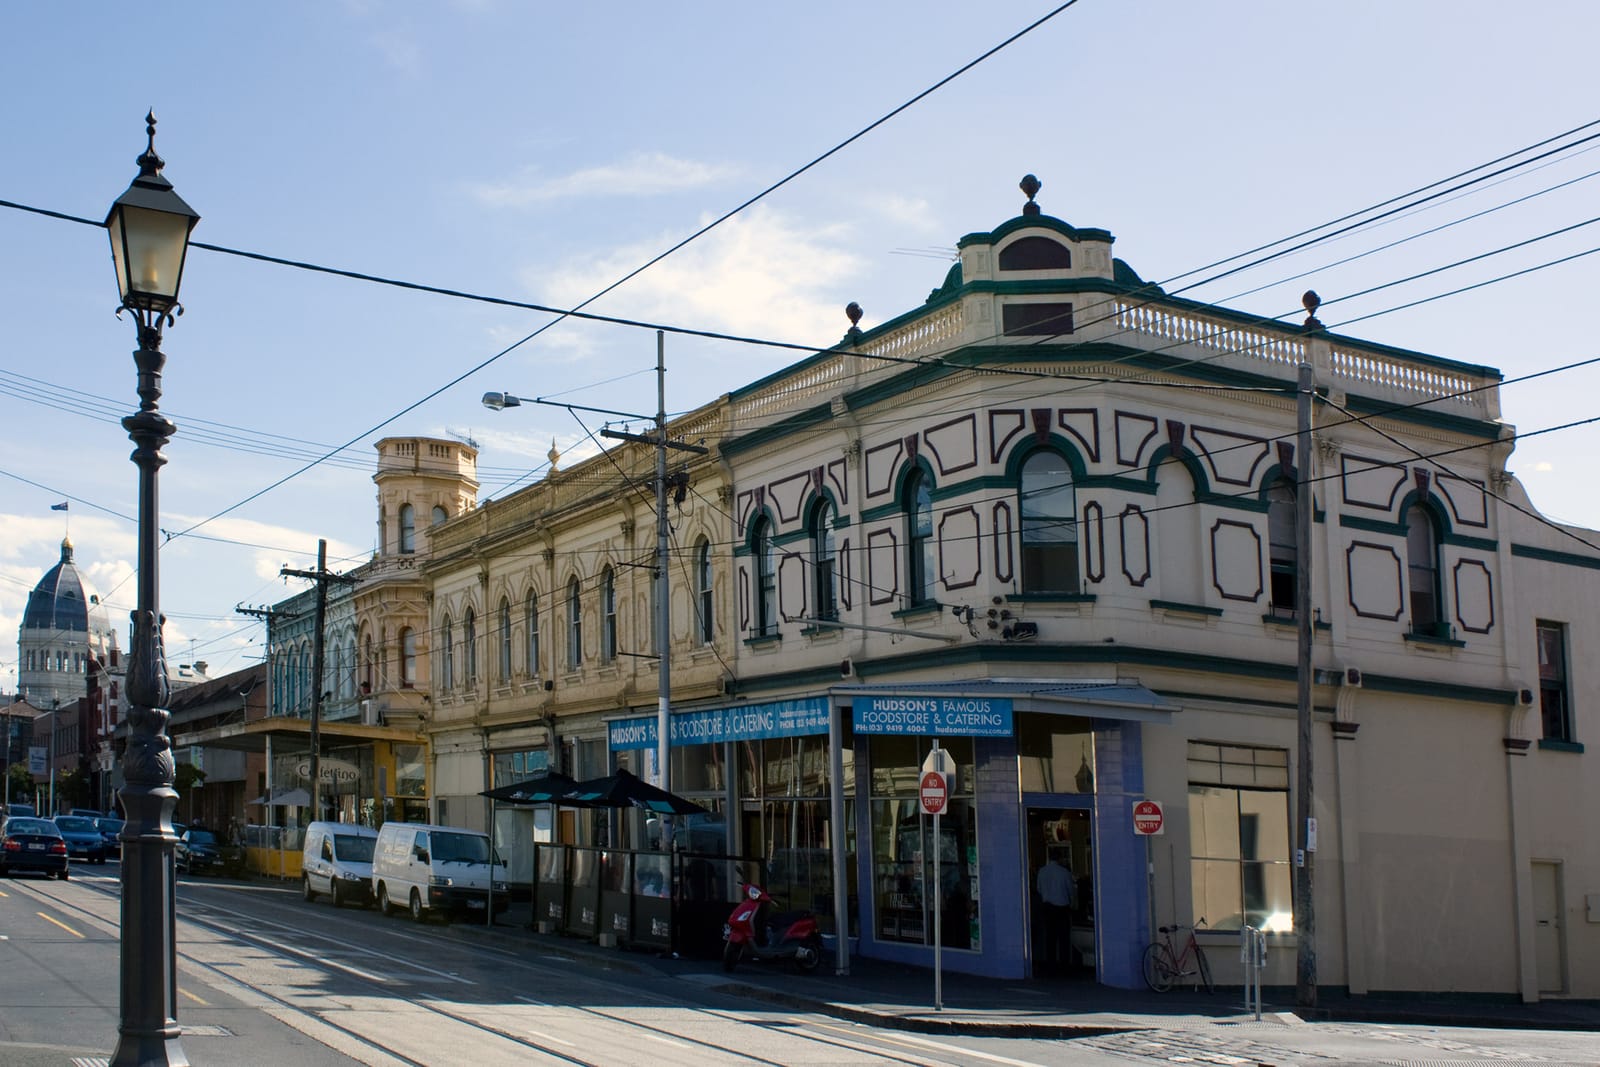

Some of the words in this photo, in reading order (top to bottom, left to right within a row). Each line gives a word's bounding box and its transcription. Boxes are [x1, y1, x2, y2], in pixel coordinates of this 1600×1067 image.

[873, 700, 937, 712] HUDSON'S
[943, 701, 991, 713] FAMOUS
[863, 712, 929, 724] FOODSTORE
[933, 713, 942, 724] &
[946, 713, 1002, 726] CATERING
[611, 724, 647, 745] HUDSON'S
[648, 723, 678, 741] FAS
[680, 717, 722, 738] FOODSTORE
[725, 716, 731, 734] &
[733, 712, 773, 733] CATERING
[886, 724, 903, 732] 9419
[928, 779, 938, 787] NO
[924, 797, 943, 806] ENTRY
[1142, 806, 1153, 814] NO
[1138, 822, 1159, 830] ENTRY
